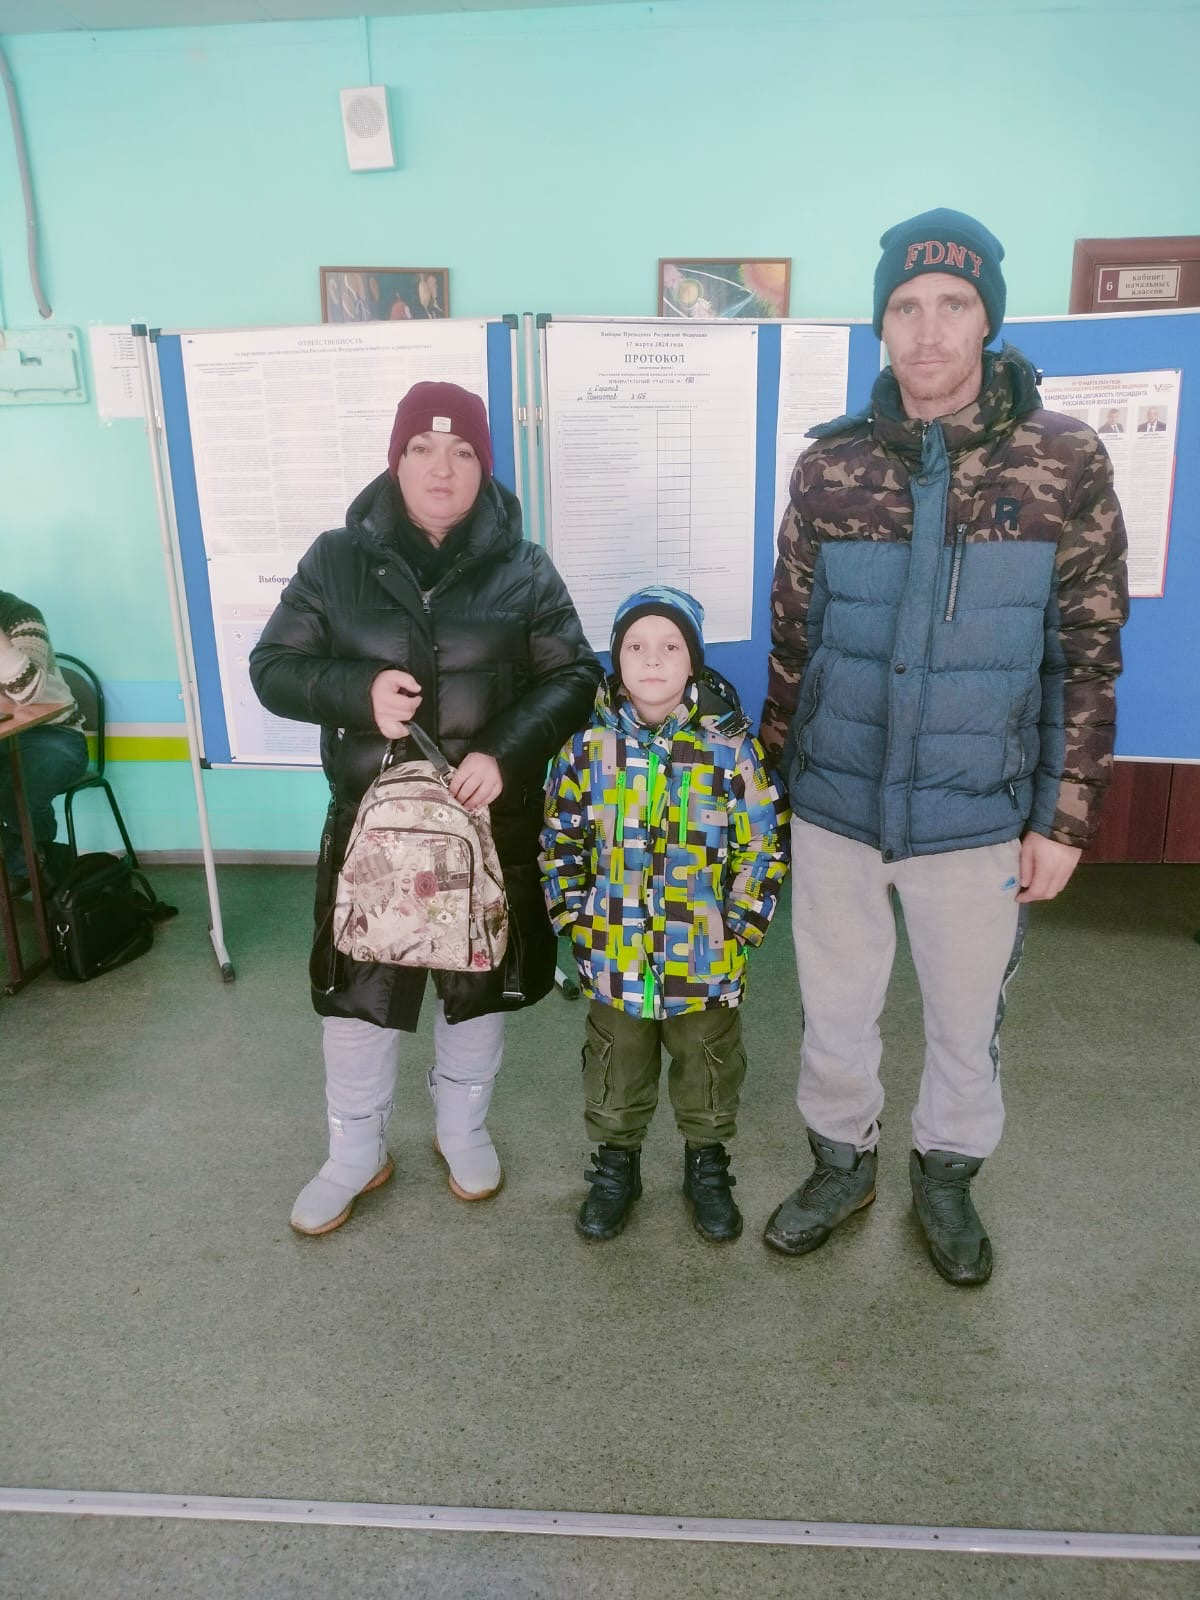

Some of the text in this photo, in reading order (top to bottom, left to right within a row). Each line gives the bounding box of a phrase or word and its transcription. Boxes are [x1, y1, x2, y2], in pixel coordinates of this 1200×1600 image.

[904, 240, 983, 278] FDNY
[1106, 281, 1113, 291] 6
[1125, 281, 1170, 289] начальных
[297, 338, 363, 347] ОТВЕТСТВЕННОСТЬ
[624, 354, 685, 363] ПРОТОКОЛ
